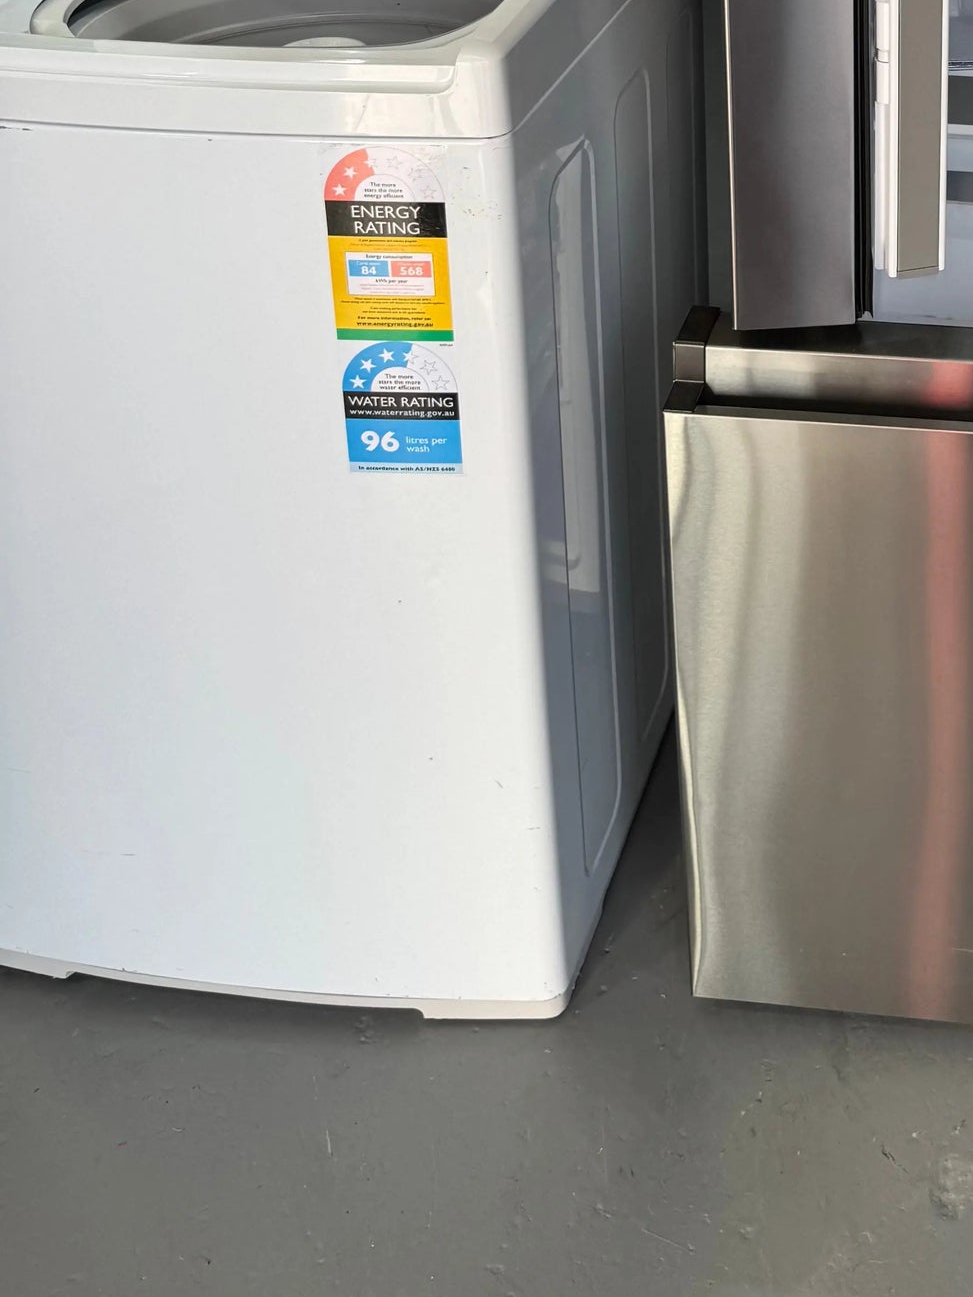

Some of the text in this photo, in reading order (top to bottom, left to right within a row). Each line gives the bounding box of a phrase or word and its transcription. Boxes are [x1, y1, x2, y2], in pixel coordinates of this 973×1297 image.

[350, 205, 421, 219] ENERGY
[353, 221, 420, 235] RATING
[361, 265, 377, 275] 84
[400, 267, 424, 276] 568
[348, 395, 454, 408] WATER RATING
[349, 409, 455, 418] www.waterrating.gov.au
[361, 430, 400, 452] 96
[405, 436, 448, 446] litres per
